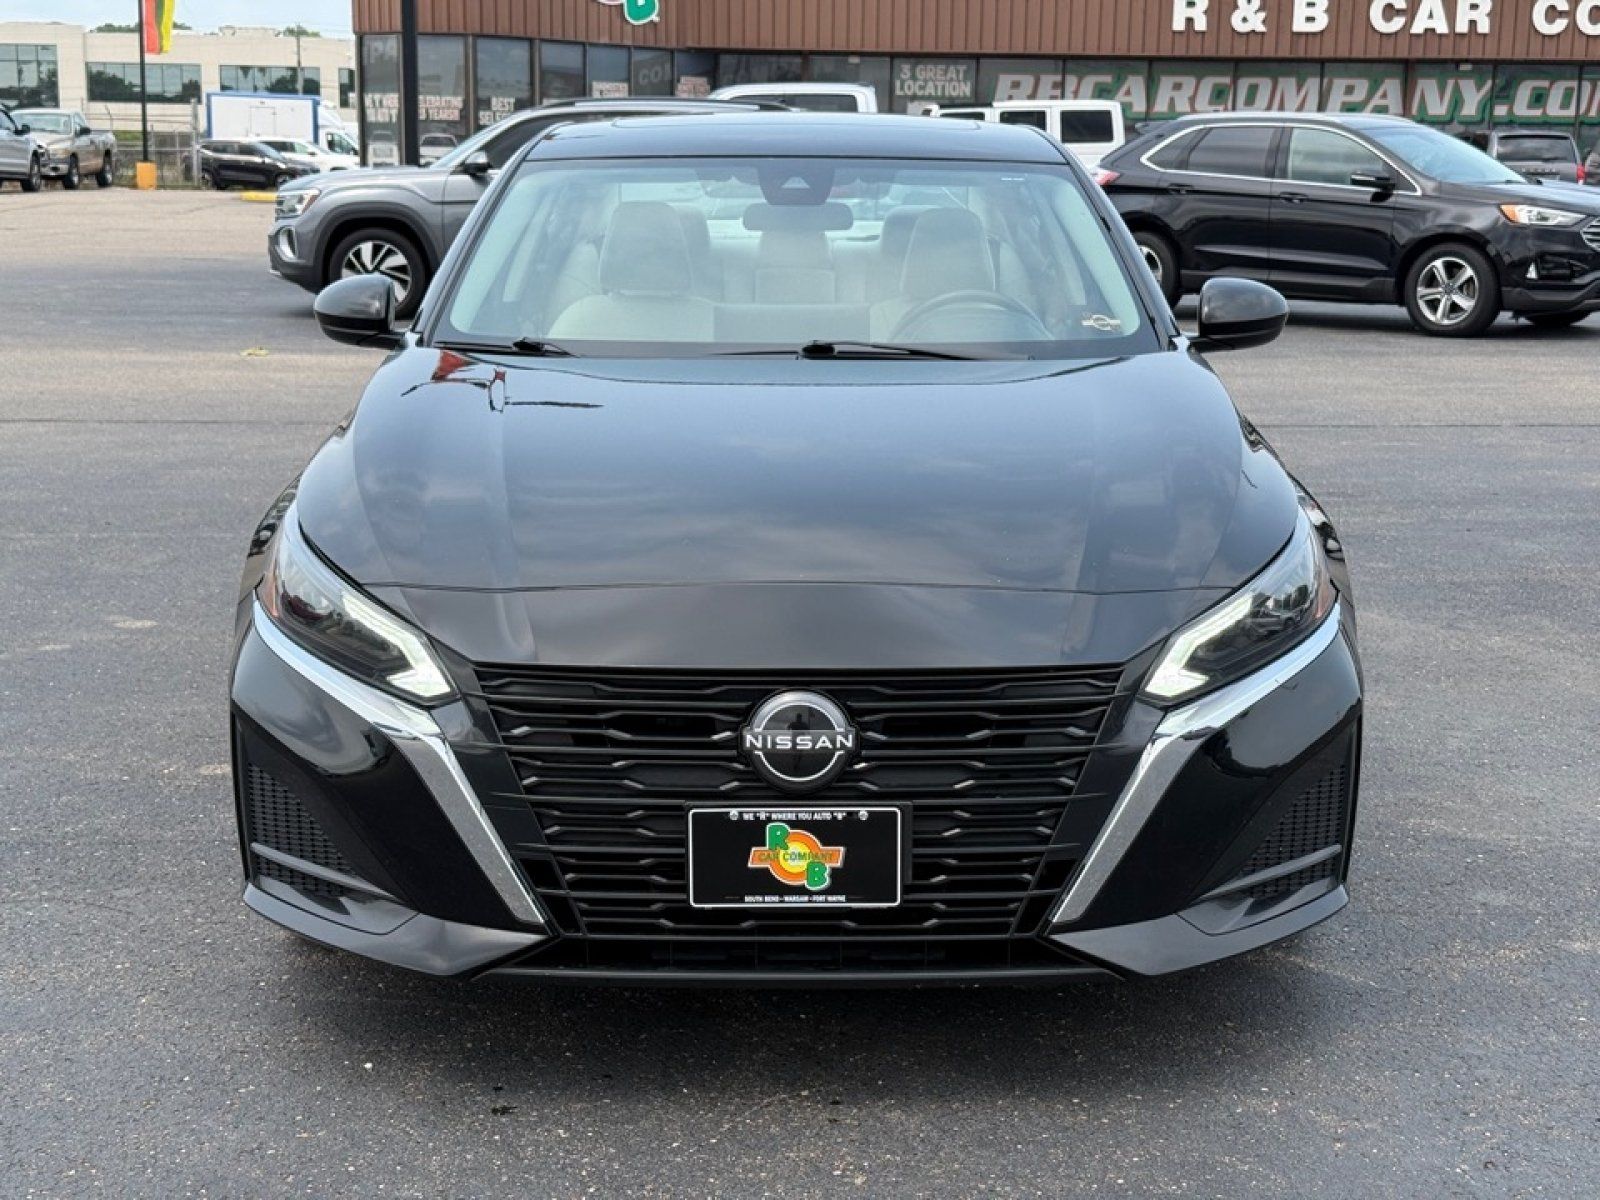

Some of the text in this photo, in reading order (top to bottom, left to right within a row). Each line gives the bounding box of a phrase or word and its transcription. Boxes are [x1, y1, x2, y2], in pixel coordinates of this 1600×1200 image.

[1171, 0, 1208, 32] R
[1230, 0, 1267, 33] &
[1292, 0, 1330, 33] B
[1369, 0, 1493, 34] CAR
[899, 64, 967, 80] 3 GREAT
[894, 79, 971, 96] LOCATION
[745, 734, 853, 750] NISSAN
[742, 812, 755, 820] WE
[771, 812, 796, 820] WHERE
[797, 812, 812, 820] YOU
[813, 812, 832, 820] AUTO
[767, 823, 789, 850] R
[758, 850, 833, 862] CAR COMPANY
[806, 861, 828, 888] B
